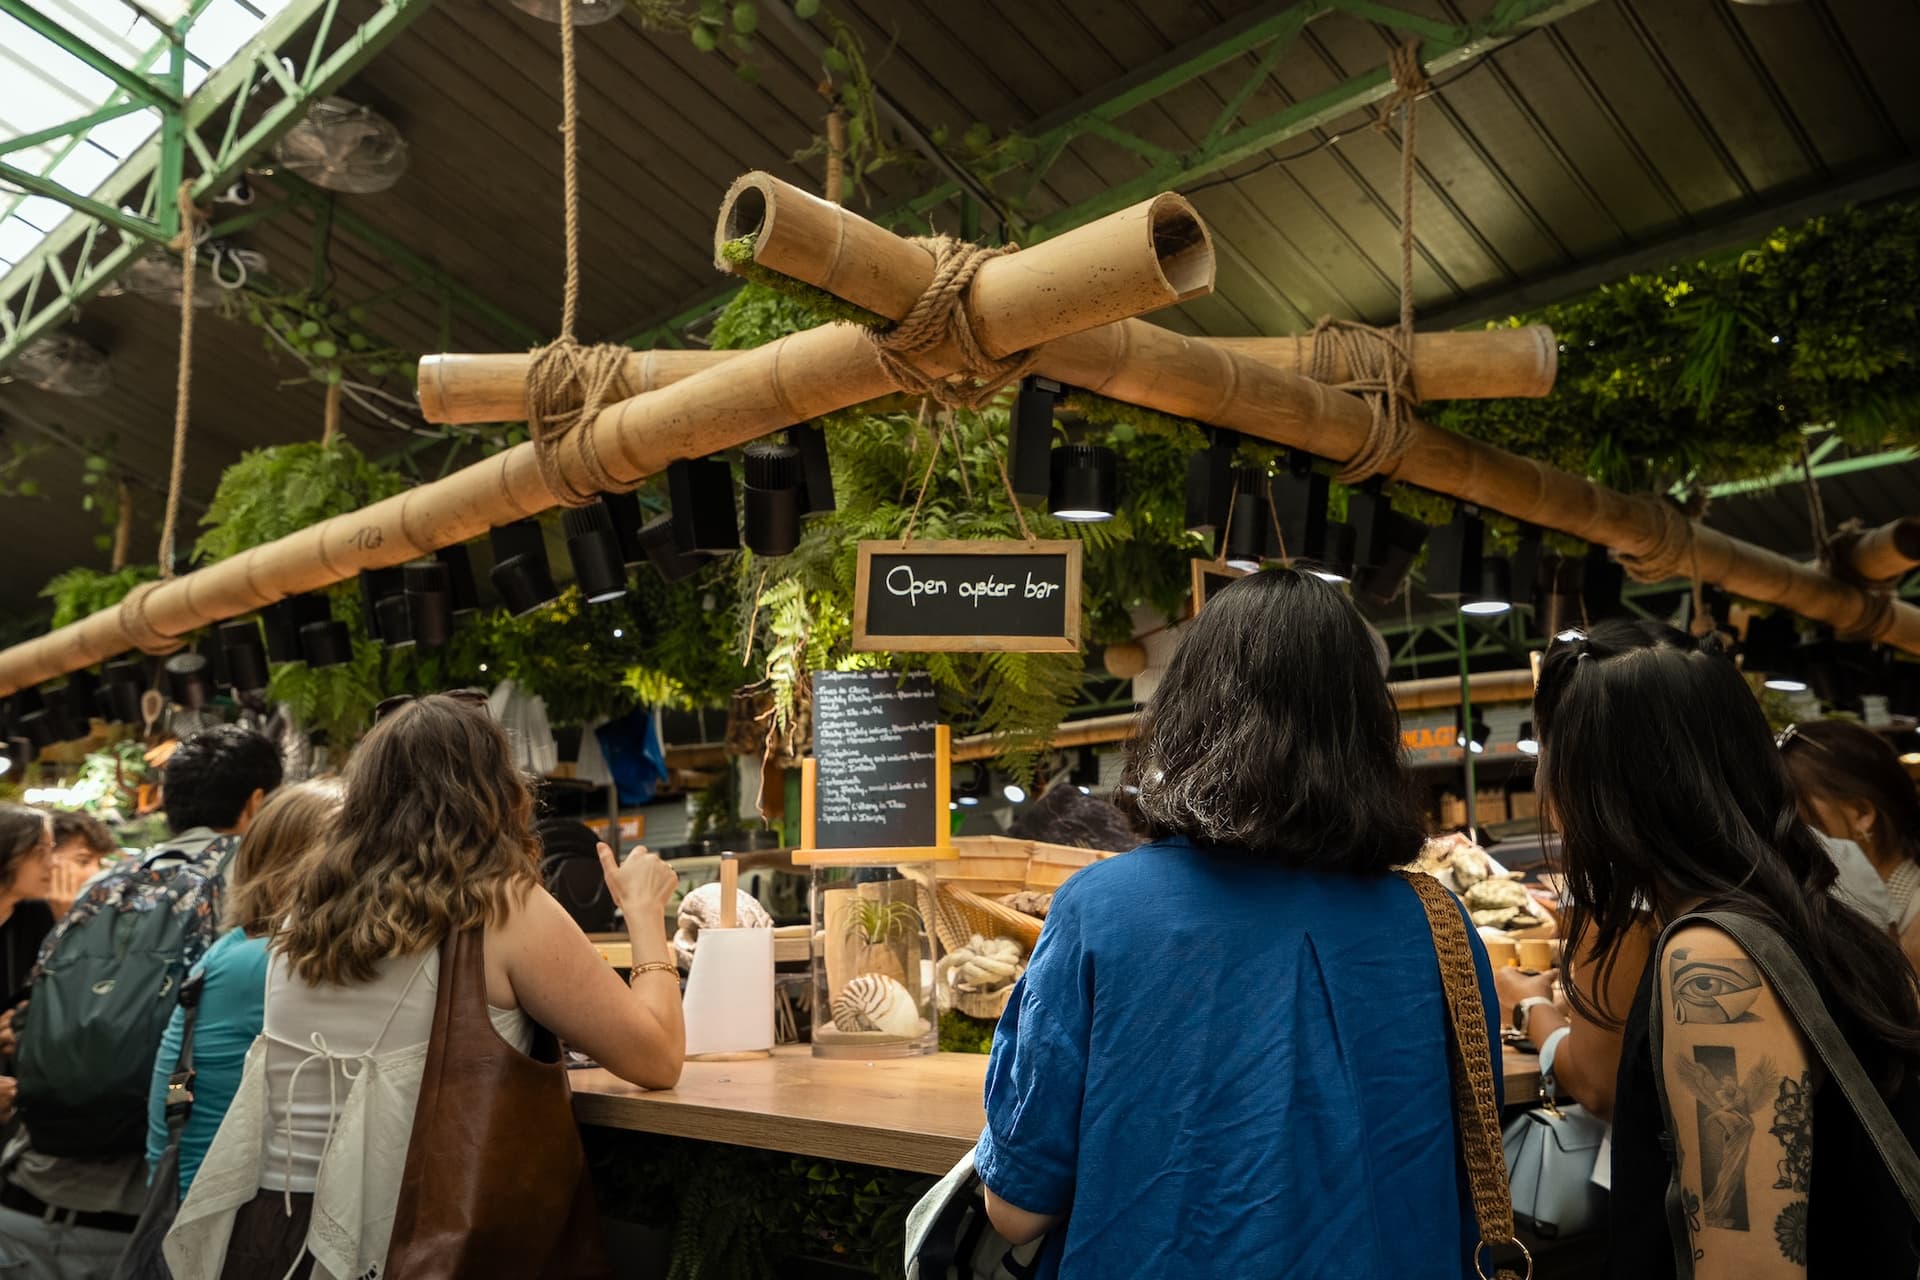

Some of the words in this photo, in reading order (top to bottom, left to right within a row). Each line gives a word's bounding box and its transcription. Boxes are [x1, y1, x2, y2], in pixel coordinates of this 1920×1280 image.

[886, 565, 947, 607] Open
[958, 574, 1016, 608] oyster
[1024, 571, 1059, 599] bar
